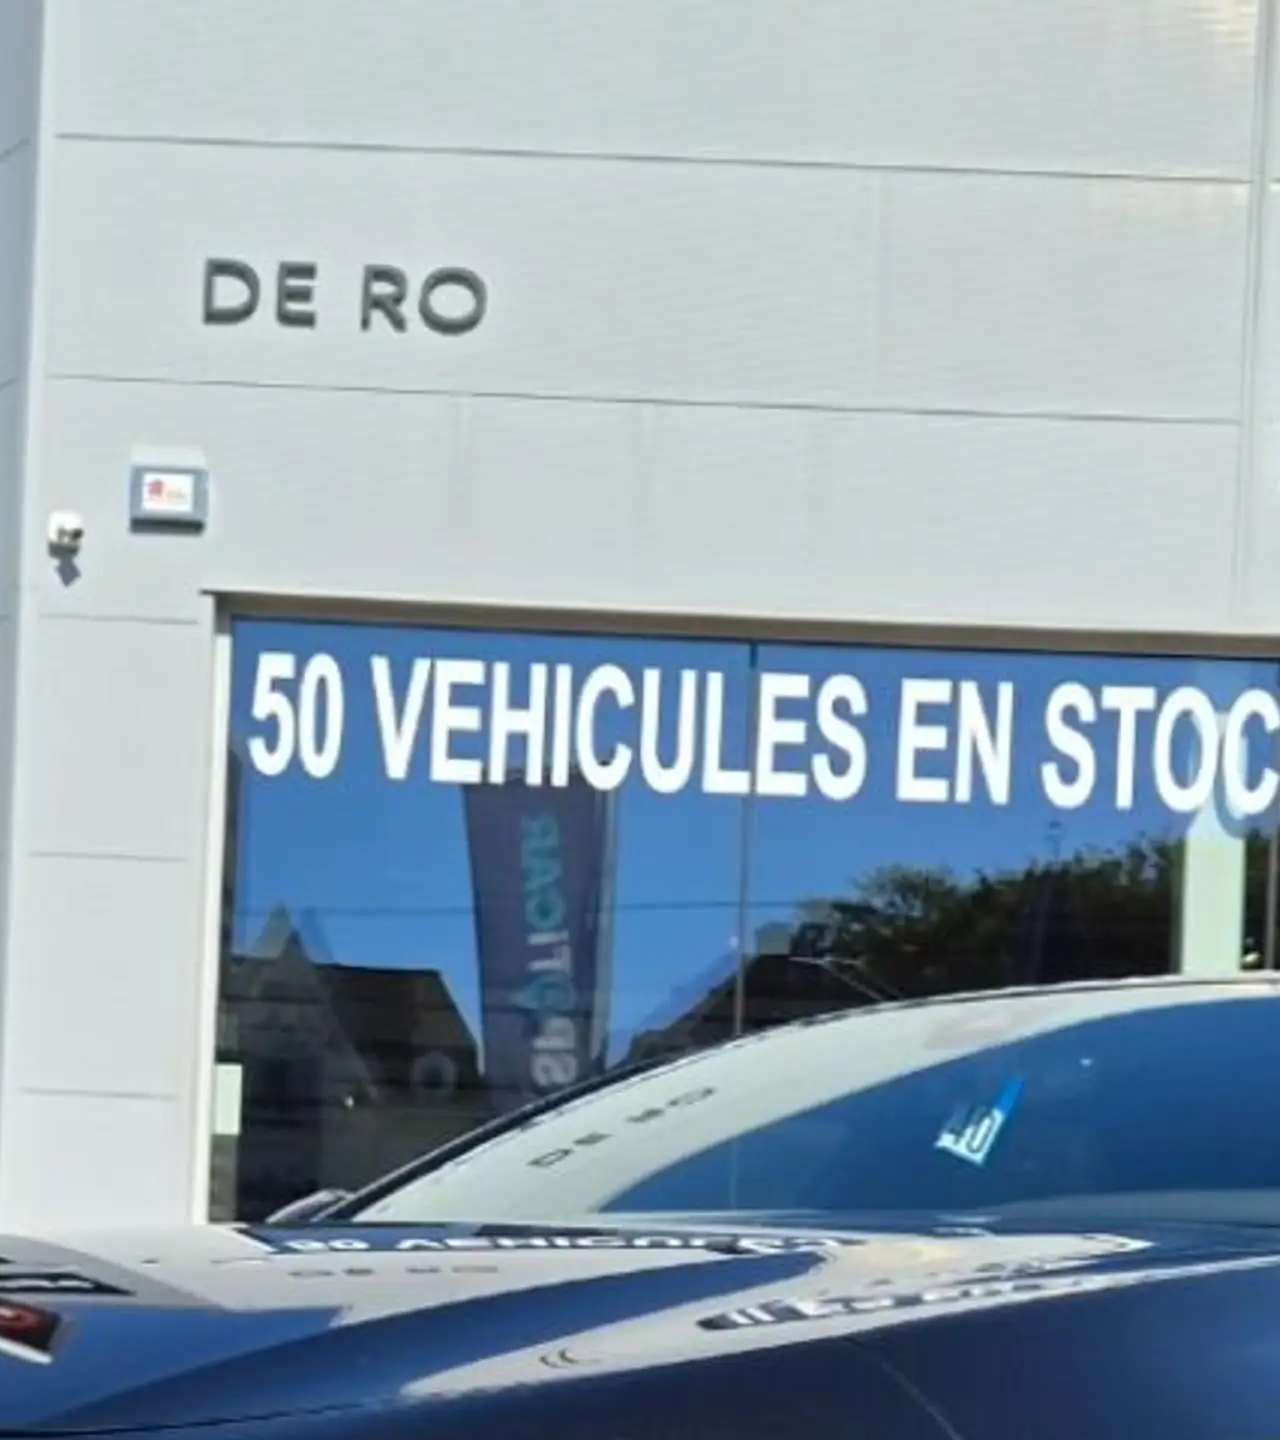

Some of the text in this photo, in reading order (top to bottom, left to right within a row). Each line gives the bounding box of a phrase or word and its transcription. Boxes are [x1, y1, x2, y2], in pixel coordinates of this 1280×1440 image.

[203, 257, 488, 336] DE RO
[248, 652, 343, 777] 50
[370, 655, 867, 800] VEHICULES
[896, 678, 1013, 806] EN
